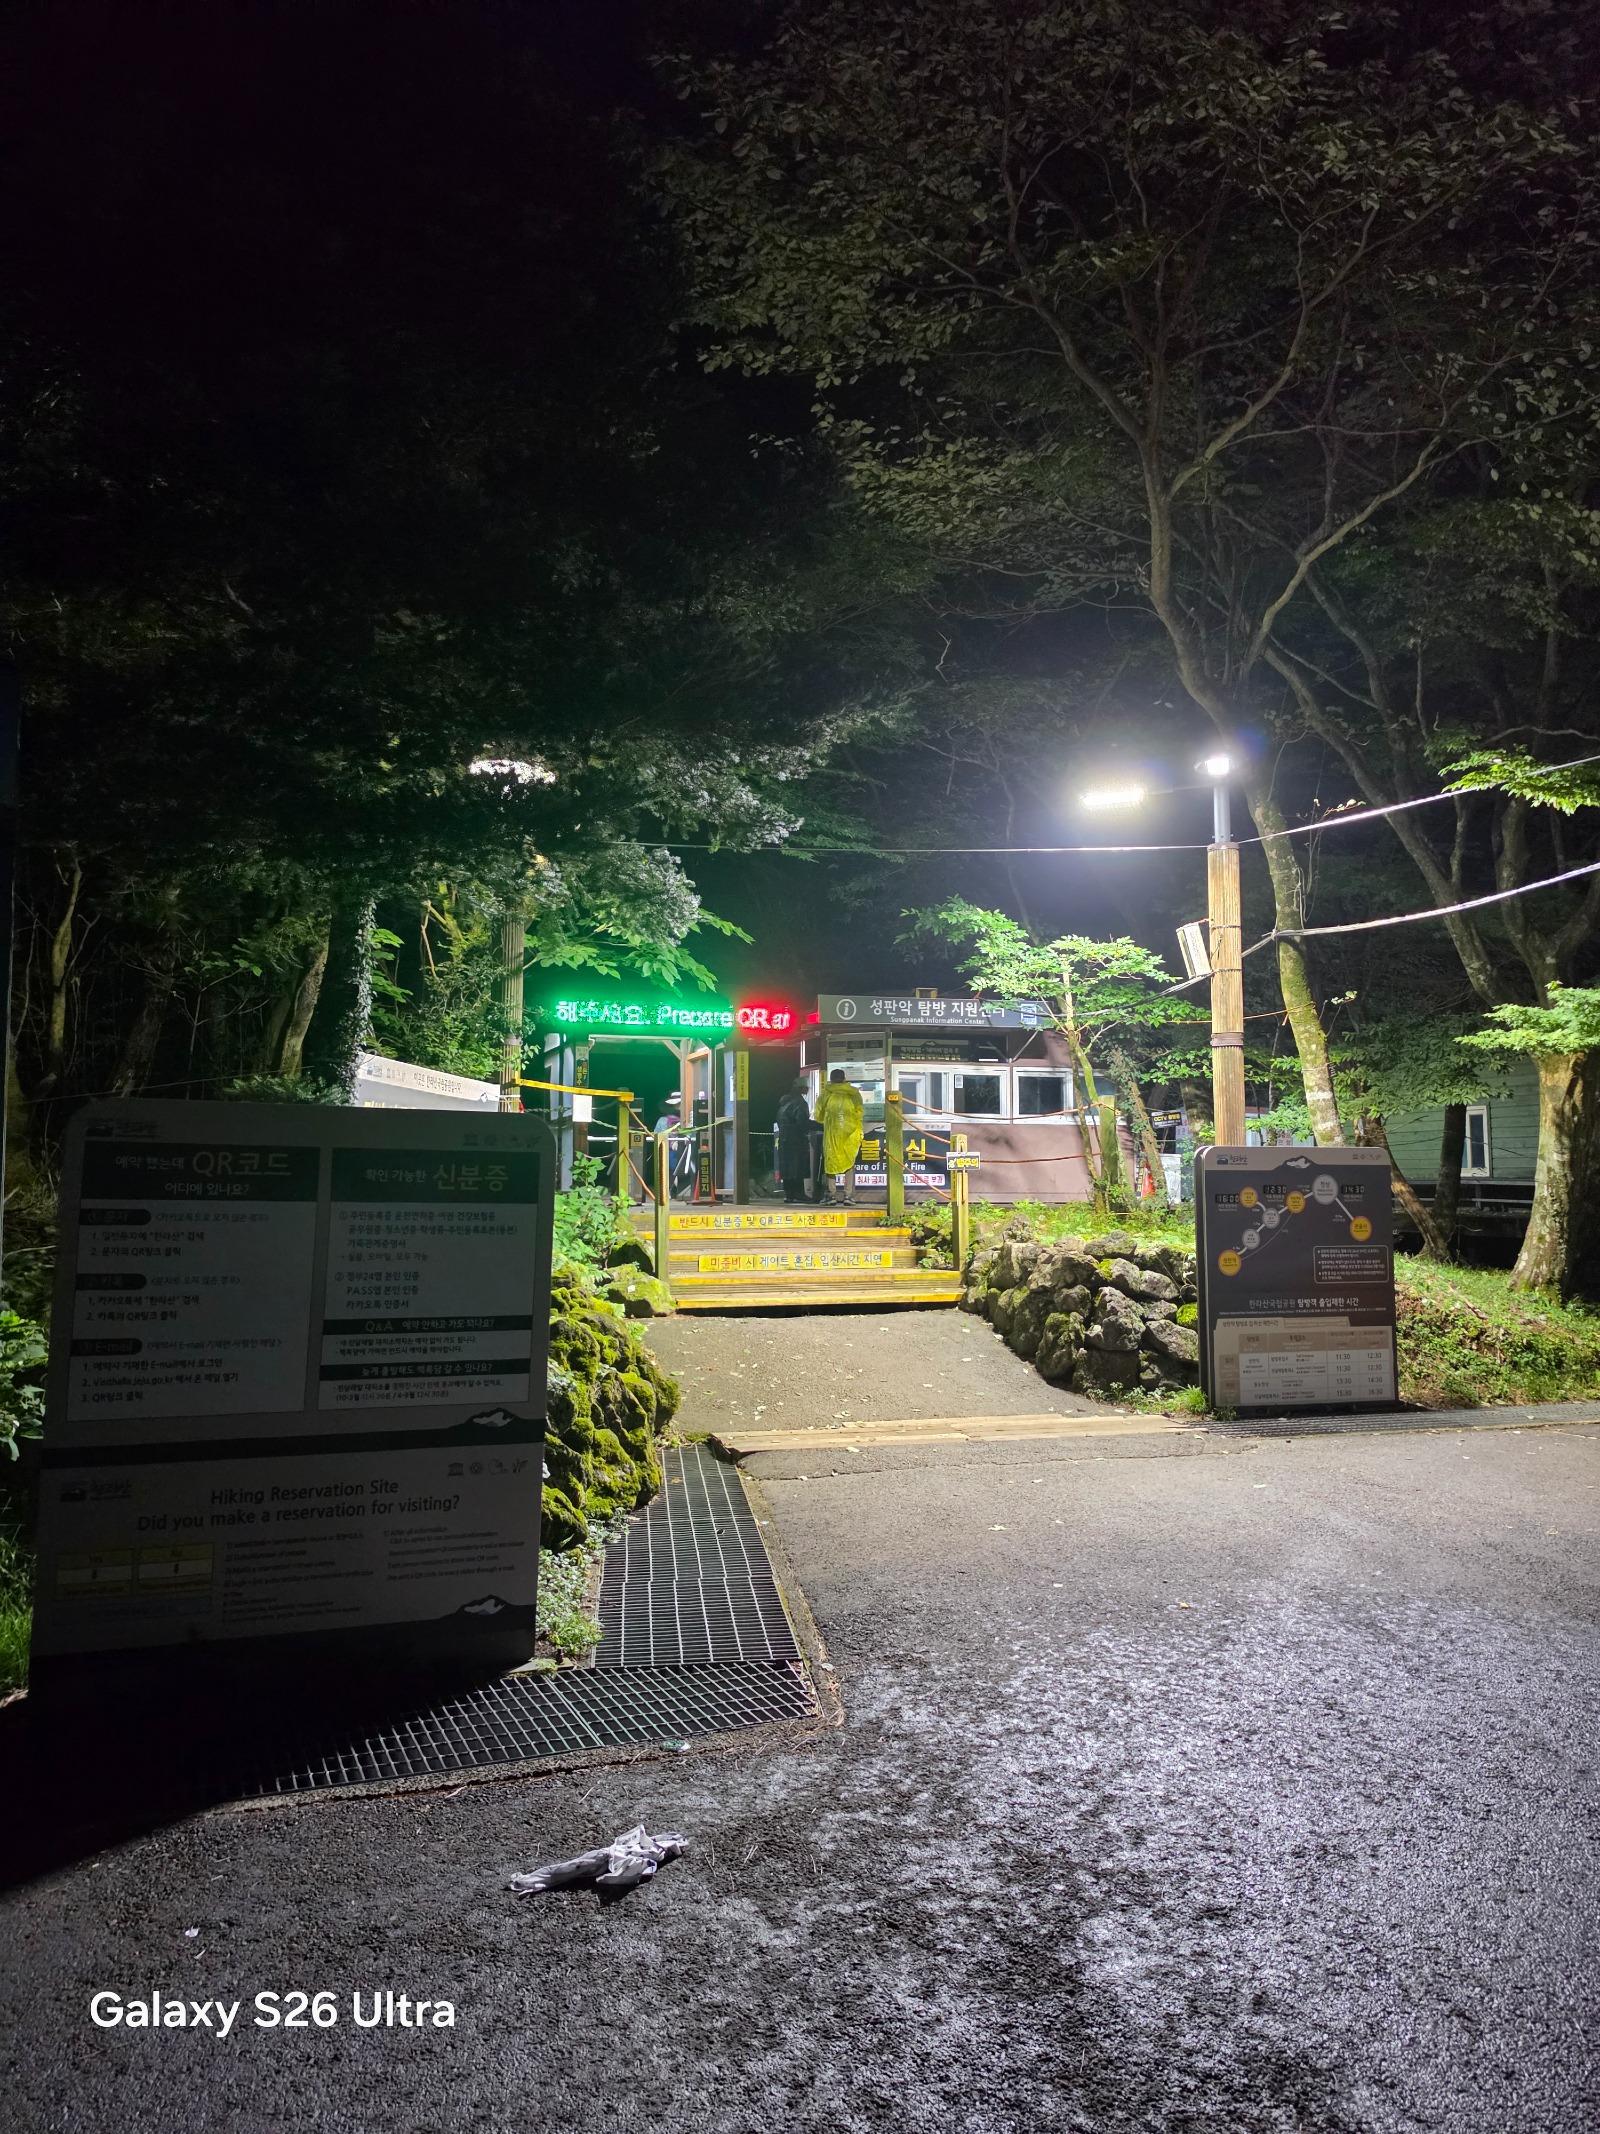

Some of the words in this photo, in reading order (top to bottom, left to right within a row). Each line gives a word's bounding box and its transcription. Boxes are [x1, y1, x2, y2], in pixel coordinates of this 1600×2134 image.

[870, 1000, 912, 1016] 성판악
[918, 1000, 946, 1017] 탐방
[115, 1154, 141, 1169] 예약
[191, 1150, 292, 1176] QR코드
[871, 1162, 882, 1171] of
[911, 1162, 925, 1171] Fire
[365, 1169, 388, 1183] 확인
[392, 1169, 428, 1183] 가능한
[433, 1164, 509, 1192] 신분증
[164, 1182, 202, 1196] 어디에
[680, 1216, 709, 1227] 반드시
[713, 1216, 742, 1227] 신분증
[746, 1216, 755, 1226] 및
[760, 1216, 794, 1226] QR코드
[798, 1215, 816, 1225] 사전
[820, 1215, 838, 1224] 준비
[711, 1257, 741, 1267] 미준비
[746, 1257, 755, 1267] 시
[760, 1256, 789, 1267] 게이트
[794, 1256, 816, 1267] 혼잡,
[820, 1255, 859, 1265] 입산시간
[864, 1254, 882, 1264] 지연
[1346, 1297, 1359, 1306] 시간
[211, 1487, 264, 1507] Hiking
[270, 1481, 364, 1503] Reservation
[369, 1479, 399, 1494] Site
[137, 1513, 166, 1531] Did
[173, 1514, 203, 1531] you
[209, 1508, 255, 1527] make
[261, 1512, 270, 1522] a
[275, 1501, 366, 1521] reservation
[371, 1499, 394, 1515] for
[399, 1494, 460, 1514] visiting?
